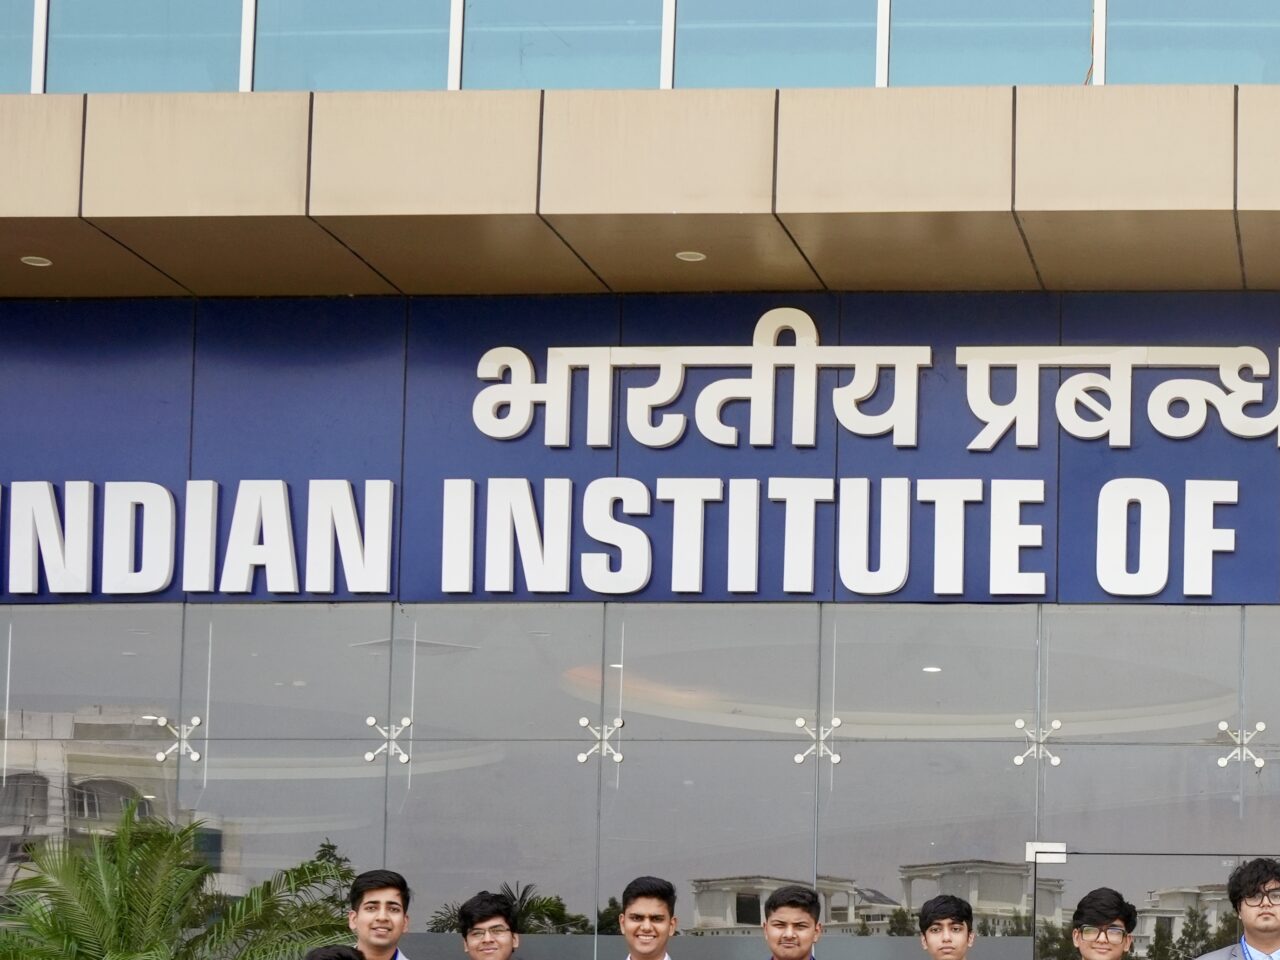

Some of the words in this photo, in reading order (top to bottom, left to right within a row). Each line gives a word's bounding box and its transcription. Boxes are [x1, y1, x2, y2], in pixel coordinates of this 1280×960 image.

[472, 307, 932, 448] भारतीय
[0, 479, 394, 594] NDIAN
[441, 477, 1046, 595] INSTITUTE
[1095, 477, 1239, 596] OF
